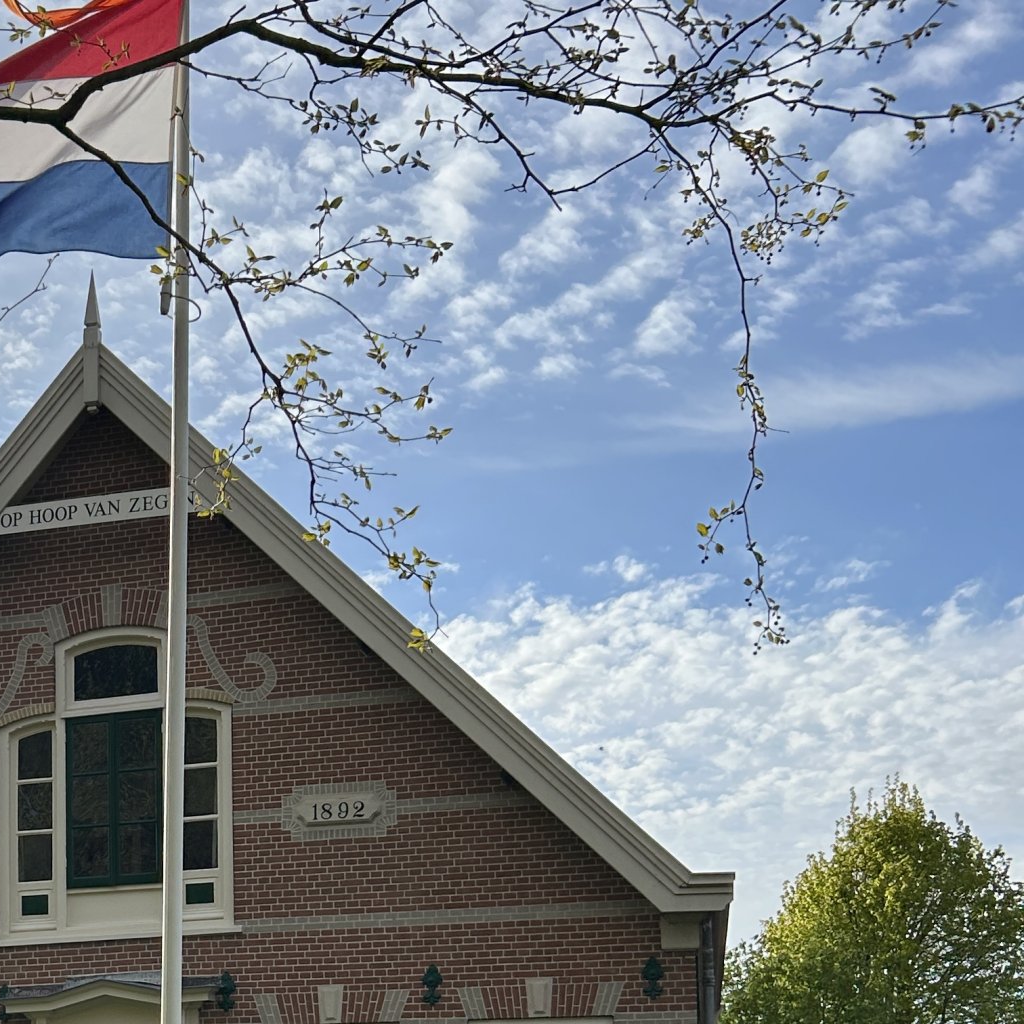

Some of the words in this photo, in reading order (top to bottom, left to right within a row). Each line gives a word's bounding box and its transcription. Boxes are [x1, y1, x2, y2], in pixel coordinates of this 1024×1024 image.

[0, 512, 23, 529] OP
[29, 504, 78, 526] HOOP
[84, 499, 121, 518] VAN
[312, 800, 365, 821] 1892
